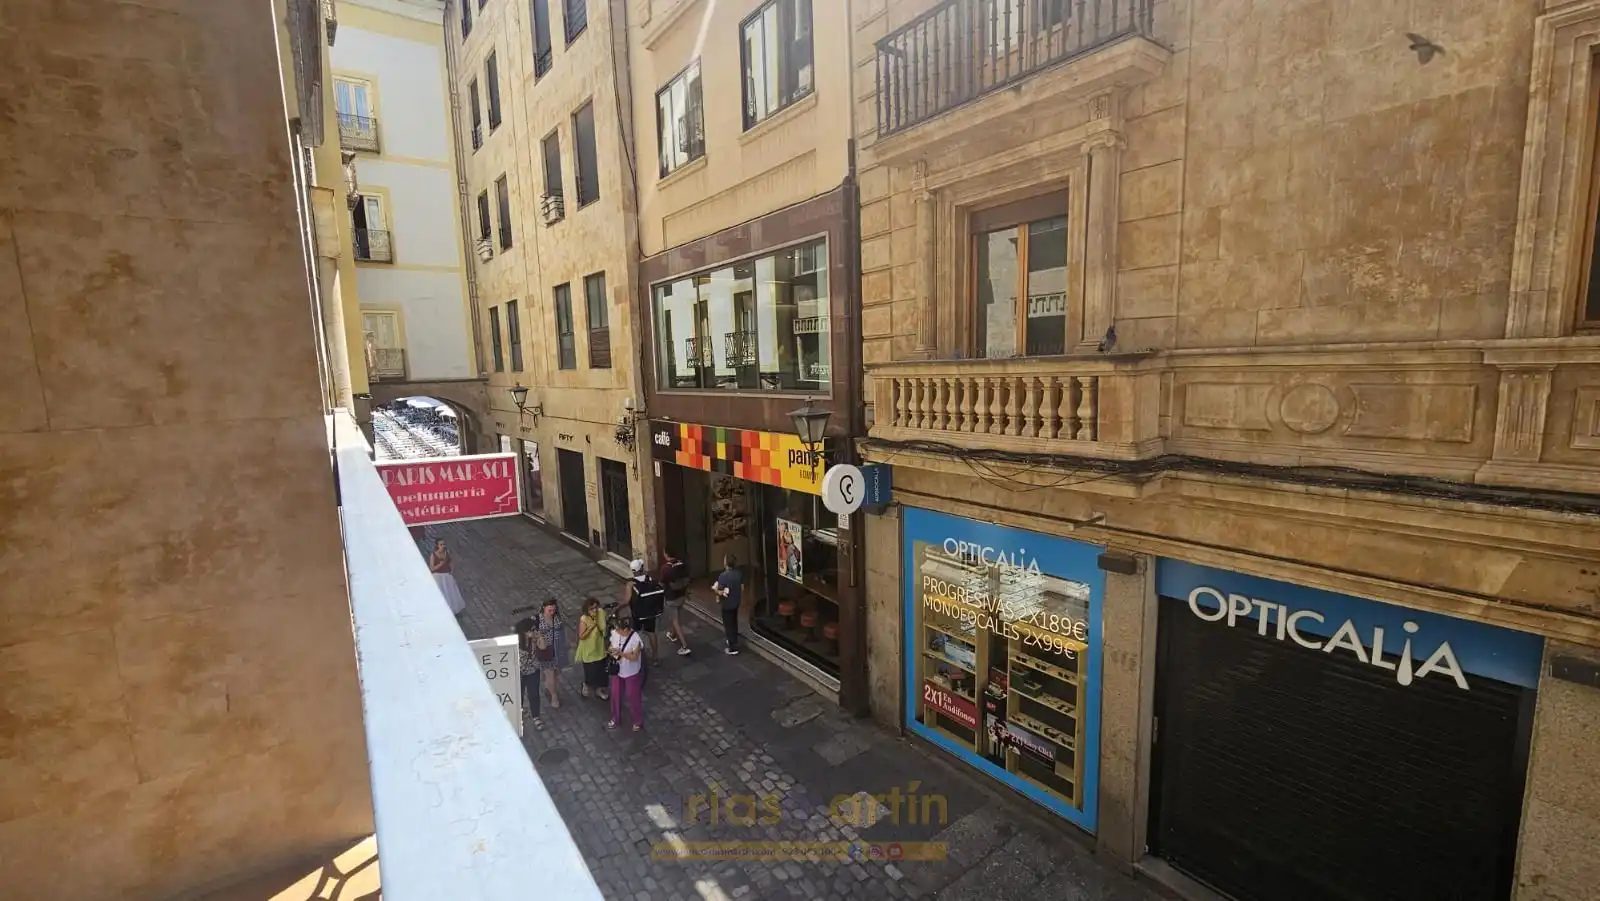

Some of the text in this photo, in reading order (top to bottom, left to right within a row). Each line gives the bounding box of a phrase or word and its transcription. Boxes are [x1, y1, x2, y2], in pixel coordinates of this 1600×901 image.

[922, 575, 1087, 642] PROGRESIVAS 2X189€
[922, 593, 1077, 661] MONOFOCALES 2X99€
